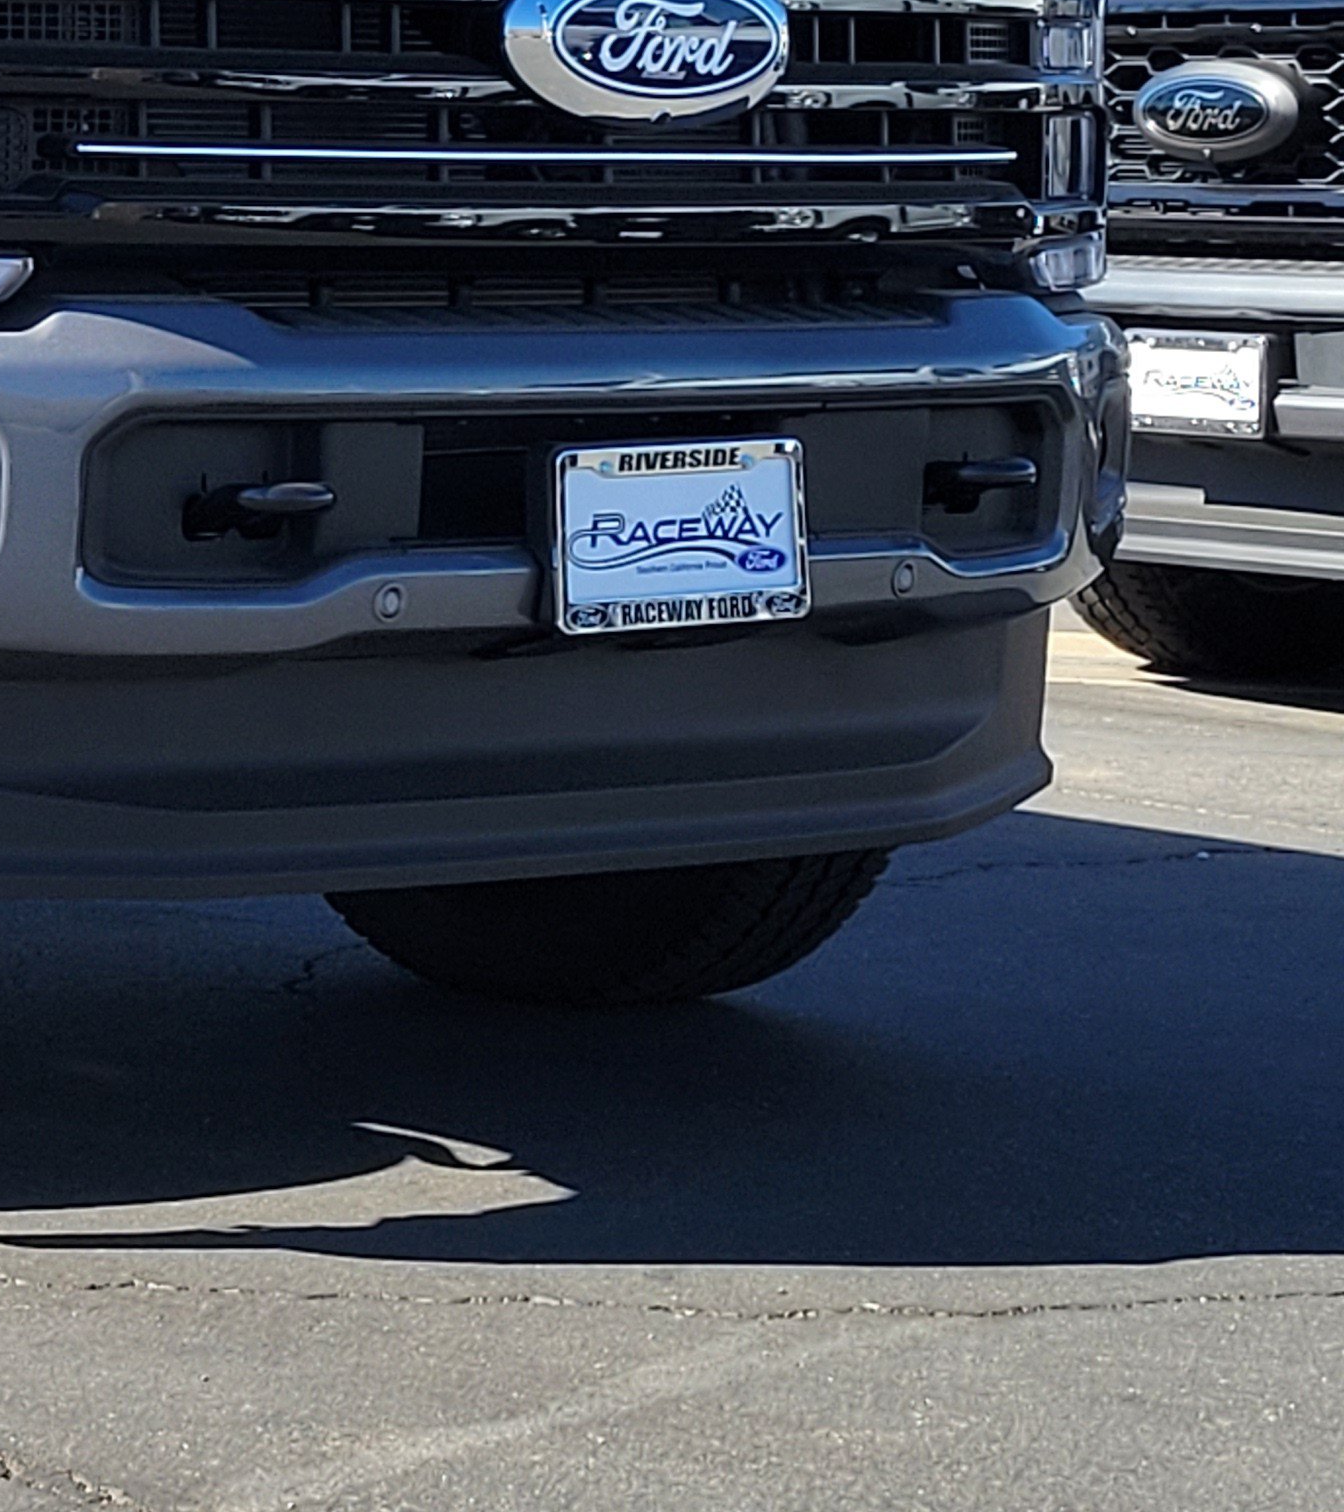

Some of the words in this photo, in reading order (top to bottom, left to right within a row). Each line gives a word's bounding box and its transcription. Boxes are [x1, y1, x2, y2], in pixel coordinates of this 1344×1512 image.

[1165, 89, 1243, 131] Ford
[619, 447, 741, 472] RIVERSIDE
[570, 512, 783, 548] RACEWAY
[622, 601, 703, 625] RACEWAY
[711, 595, 754, 619] FORD
